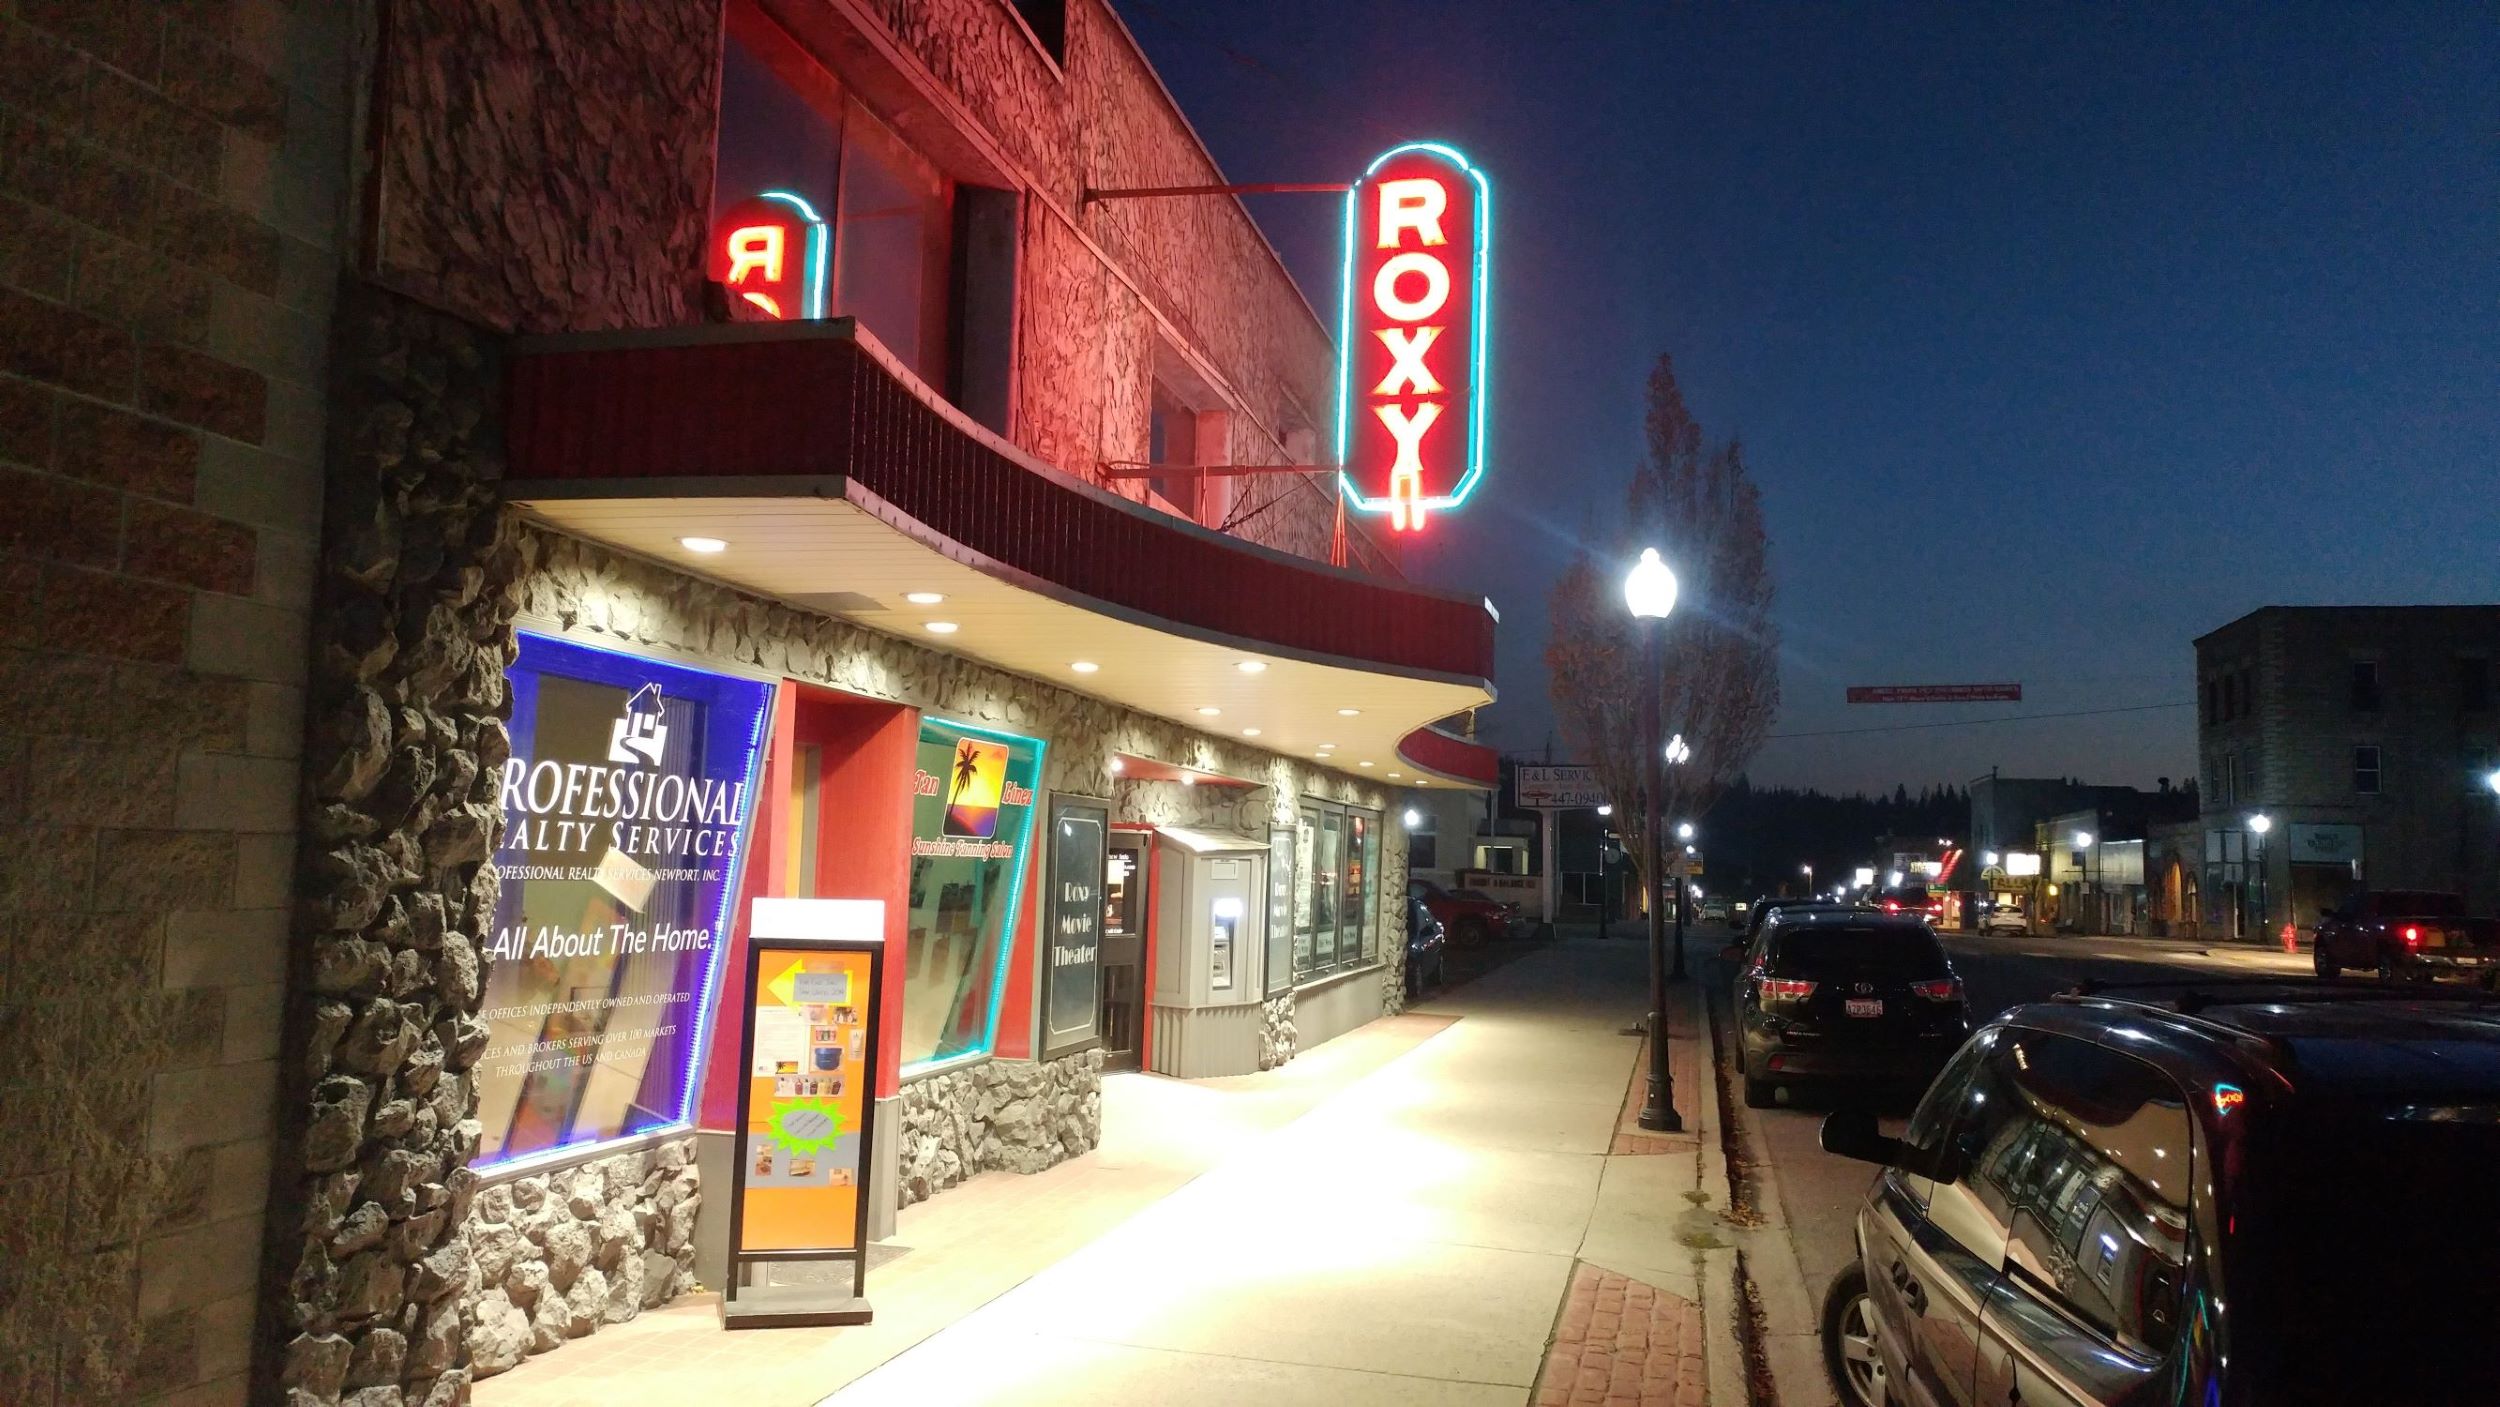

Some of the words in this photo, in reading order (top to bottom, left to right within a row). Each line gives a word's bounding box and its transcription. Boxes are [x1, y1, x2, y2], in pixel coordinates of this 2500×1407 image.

[1370, 178, 1450, 475] ROXY
[500, 757, 744, 825] ROFESSIONAL
[914, 769, 940, 796] Tan
[608, 821, 739, 857] SERVICES
[912, 837, 955, 857] Sunshine
[955, 839, 991, 862] Tanning
[991, 841, 1013, 858] Salon
[496, 864, 565, 880] OFESSIONAL
[702, 869, 721, 882] INC.
[1065, 882, 1089, 903] Roxy
[1061, 913, 1092, 935] Movie
[492, 926, 528, 960] All
[529, 925, 604, 959] About
[609, 924, 647, 955] The
[651, 922, 712, 951] Home.
[1054, 944, 1096, 967] Theater
[489, 1005, 528, 1020] OFFICES
[529, 999, 601, 1017] INDEPENDENTLY
[602, 995, 633, 1009] OWNED
[633, 994, 652, 1006] AND
[653, 992, 690, 1005] OPERATED
[503, 1044, 525, 1057] AND
[527, 1038, 567, 1055] BROKERS
[568, 1032, 605, 1049] SERVING
[605, 1032, 627, 1044] OVER
[628, 1028, 643, 1041] 100
[643, 1025, 676, 1039] MARKETS
[496, 1057, 561, 1079] THROUGHOUT
[562, 1054, 581, 1068] THE
[582, 1053, 594, 1065] US
[594, 1051, 613, 1063] AND
[614, 1047, 647, 1060] CANADA
